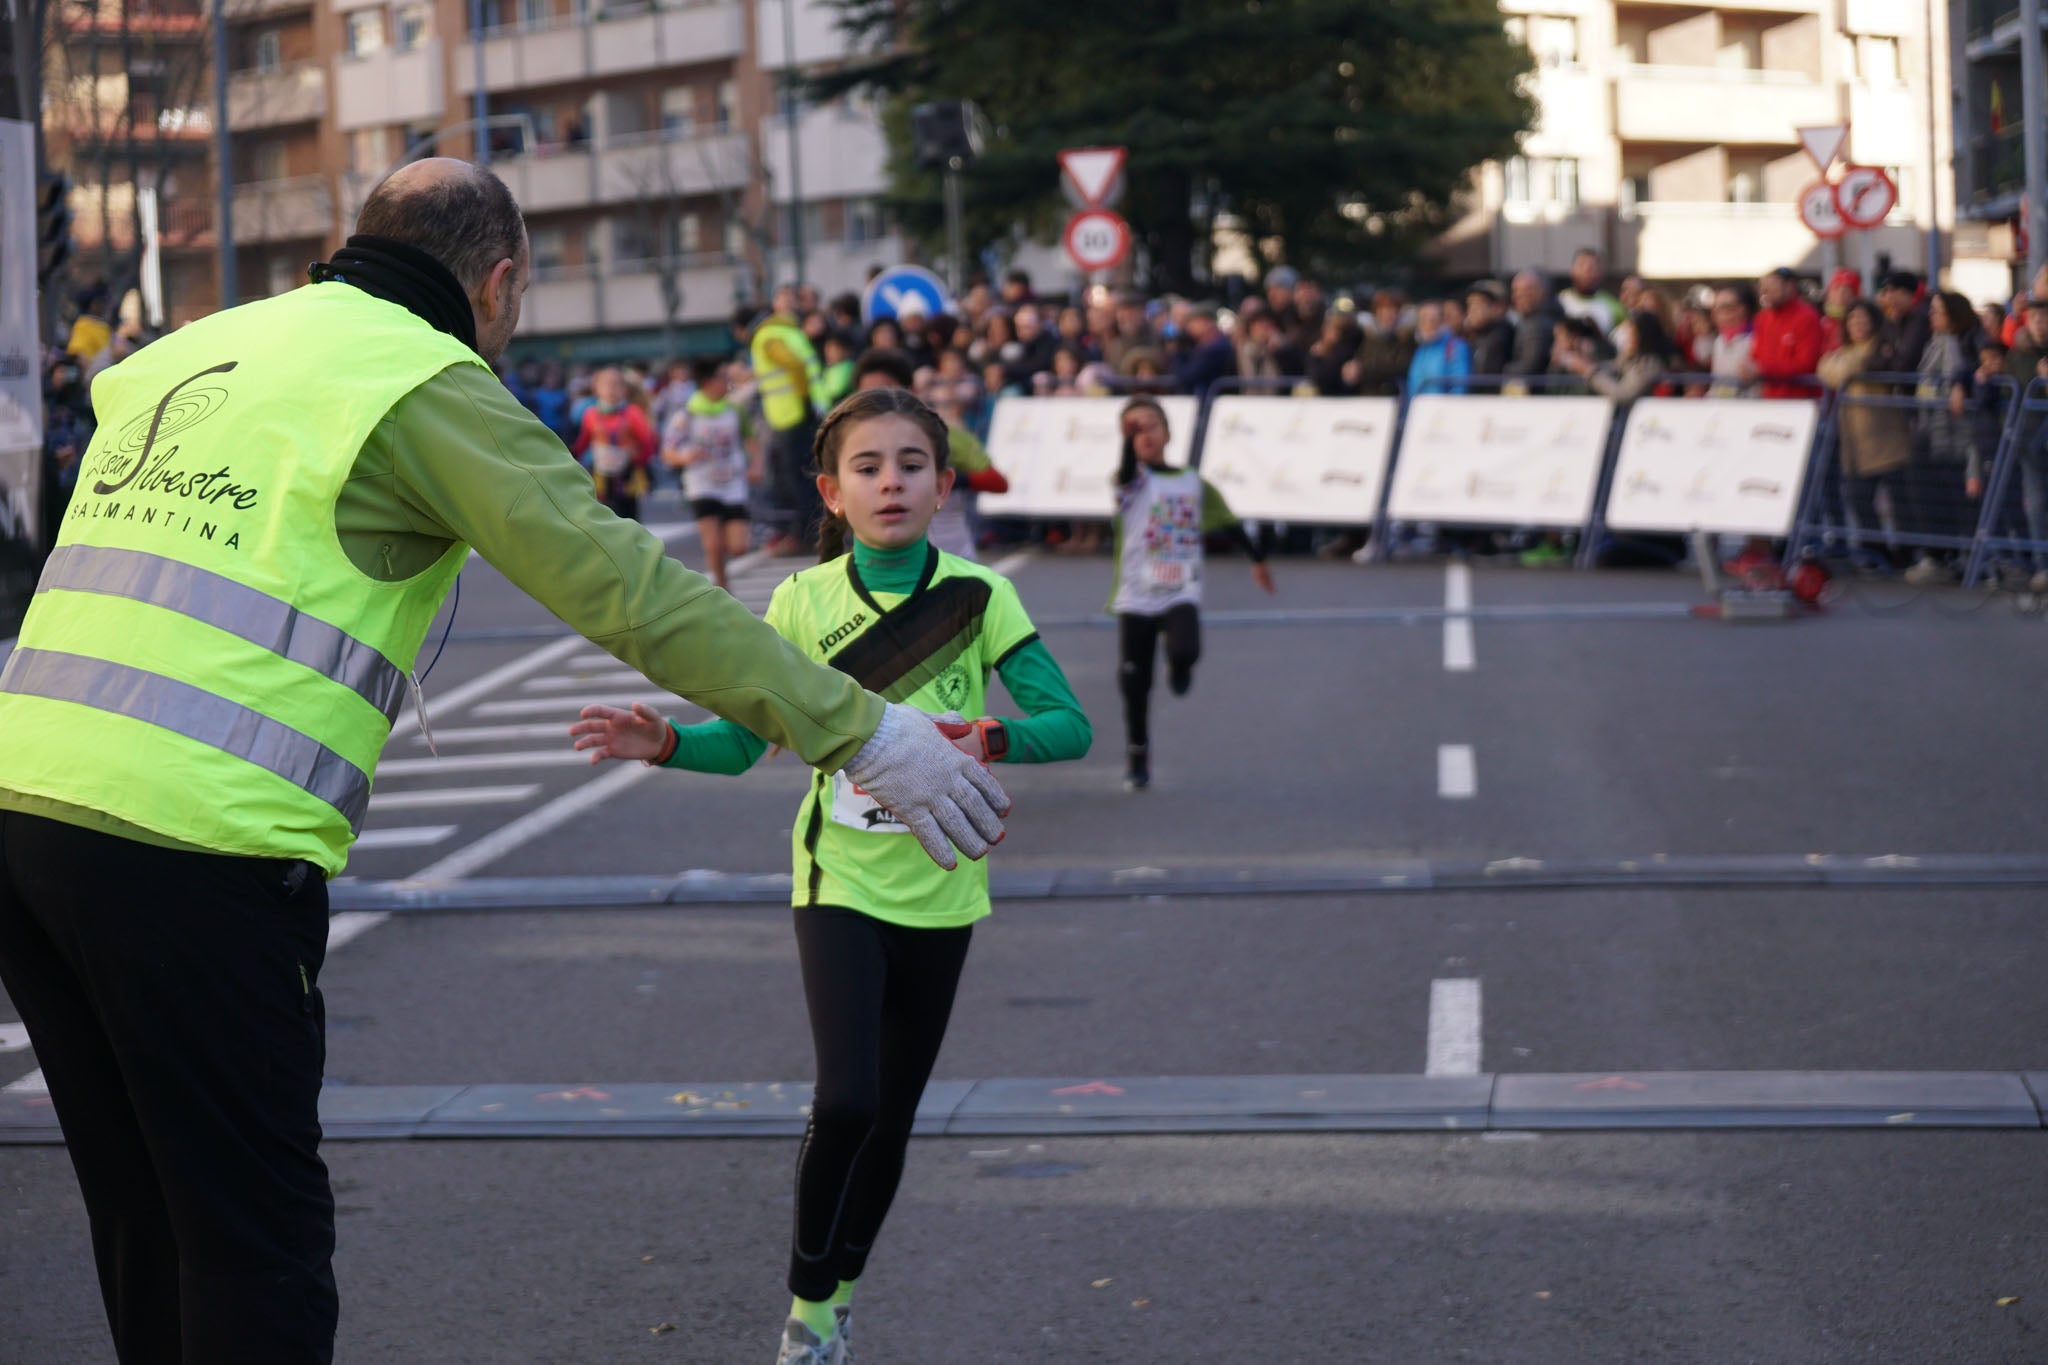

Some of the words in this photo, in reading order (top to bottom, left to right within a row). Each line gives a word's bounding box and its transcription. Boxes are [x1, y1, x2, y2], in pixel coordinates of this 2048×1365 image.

[93, 361, 258, 510] Silvestre
[71, 502, 240, 550] SALMANTINA
[818, 613, 866, 654] Joma
